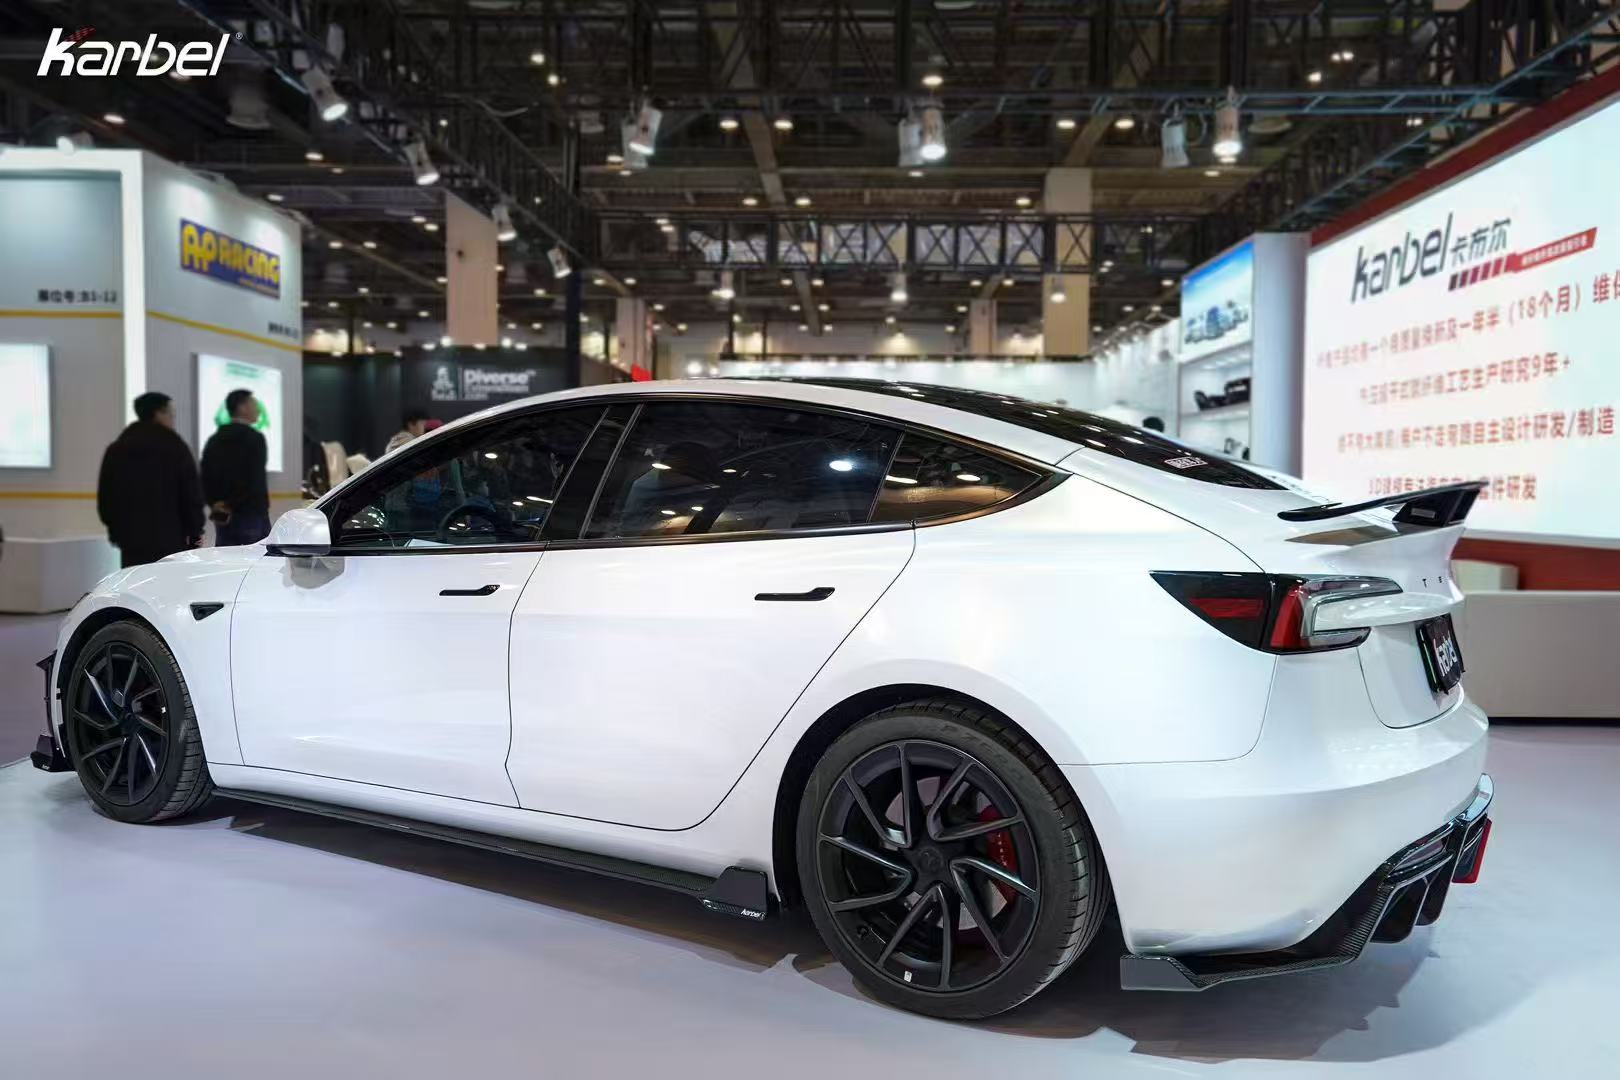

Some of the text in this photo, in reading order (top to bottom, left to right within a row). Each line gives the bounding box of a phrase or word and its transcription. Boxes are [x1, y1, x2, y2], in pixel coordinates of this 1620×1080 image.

[1351, 212, 1453, 304] karbel
[1450, 218, 1512, 266] 卡布尔
